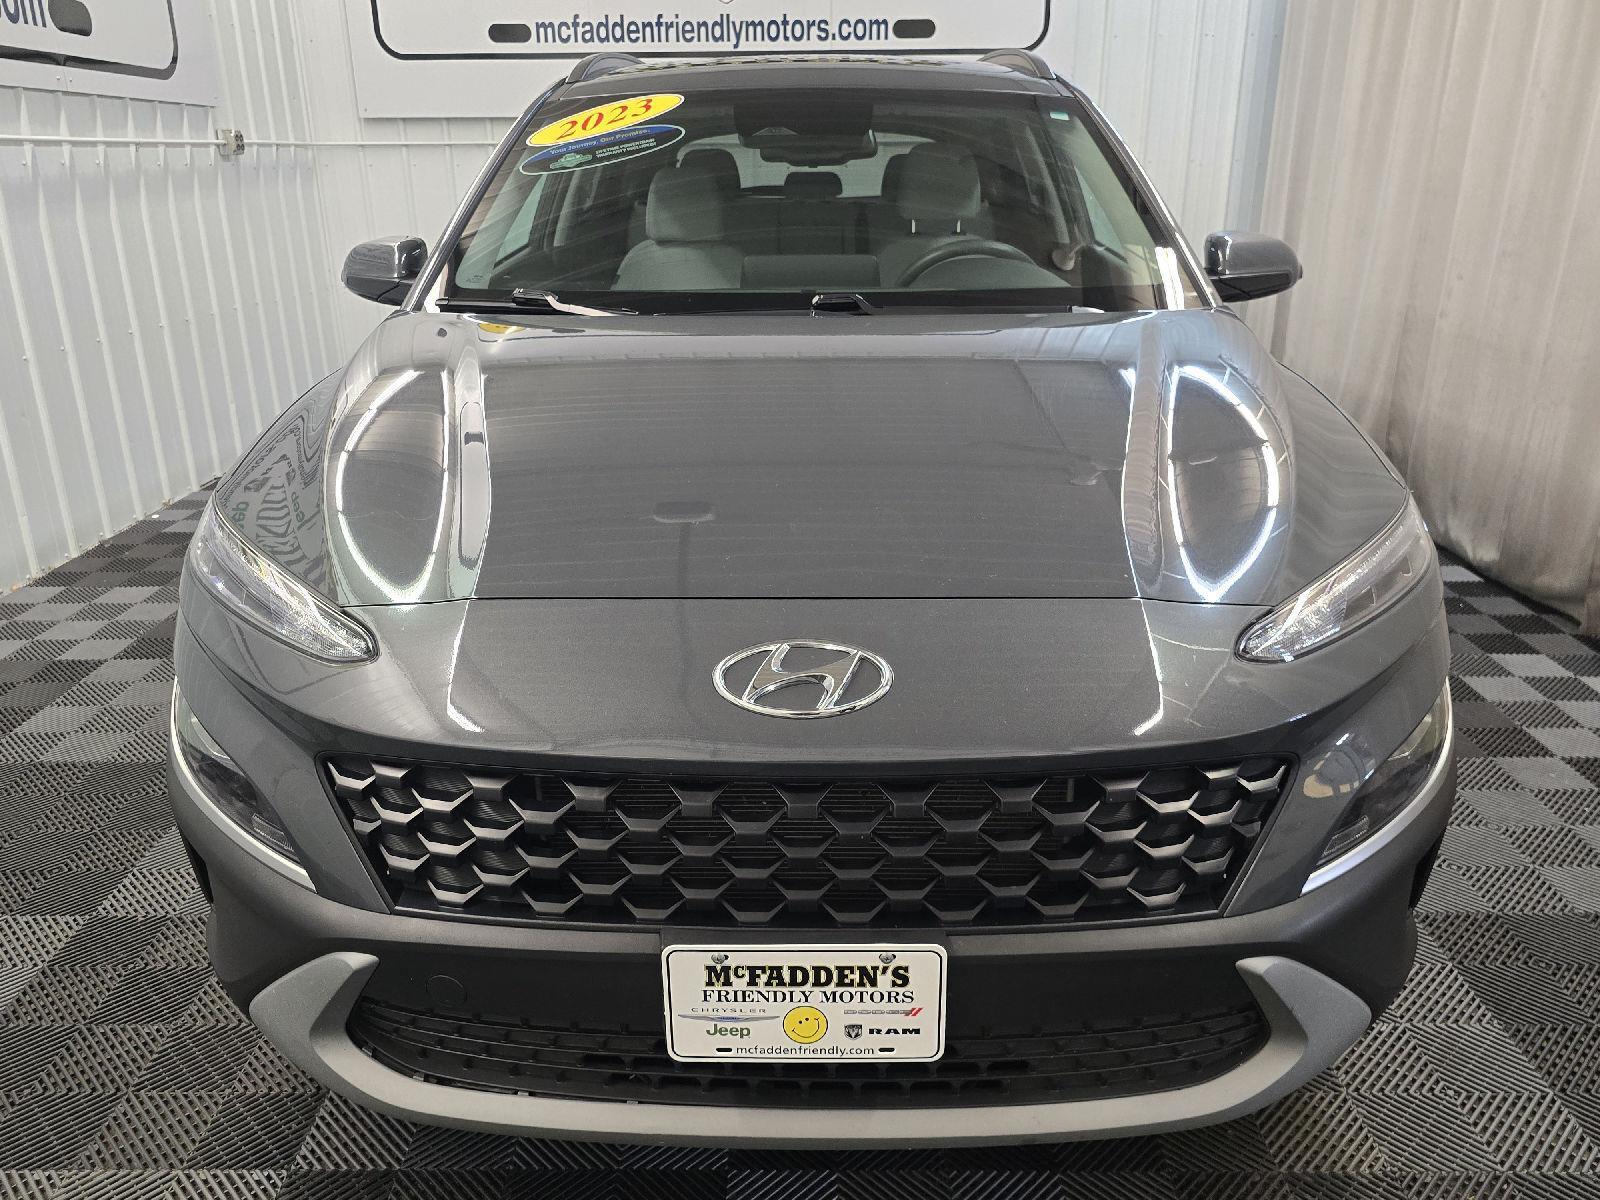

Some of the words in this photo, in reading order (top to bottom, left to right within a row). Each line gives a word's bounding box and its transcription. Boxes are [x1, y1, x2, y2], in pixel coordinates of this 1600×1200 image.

[535, 14, 889, 49] mcfaddenfriendlymotors.com
[556, 98, 653, 141] 2023
[702, 989, 813, 1004] FRIENDLY
[819, 989, 914, 1004] MOTORS
[705, 1023, 751, 1039] Jeep
[868, 1027, 921, 1035] RAM
[736, 1045, 875, 1056] mcfaddenfriendly.com
